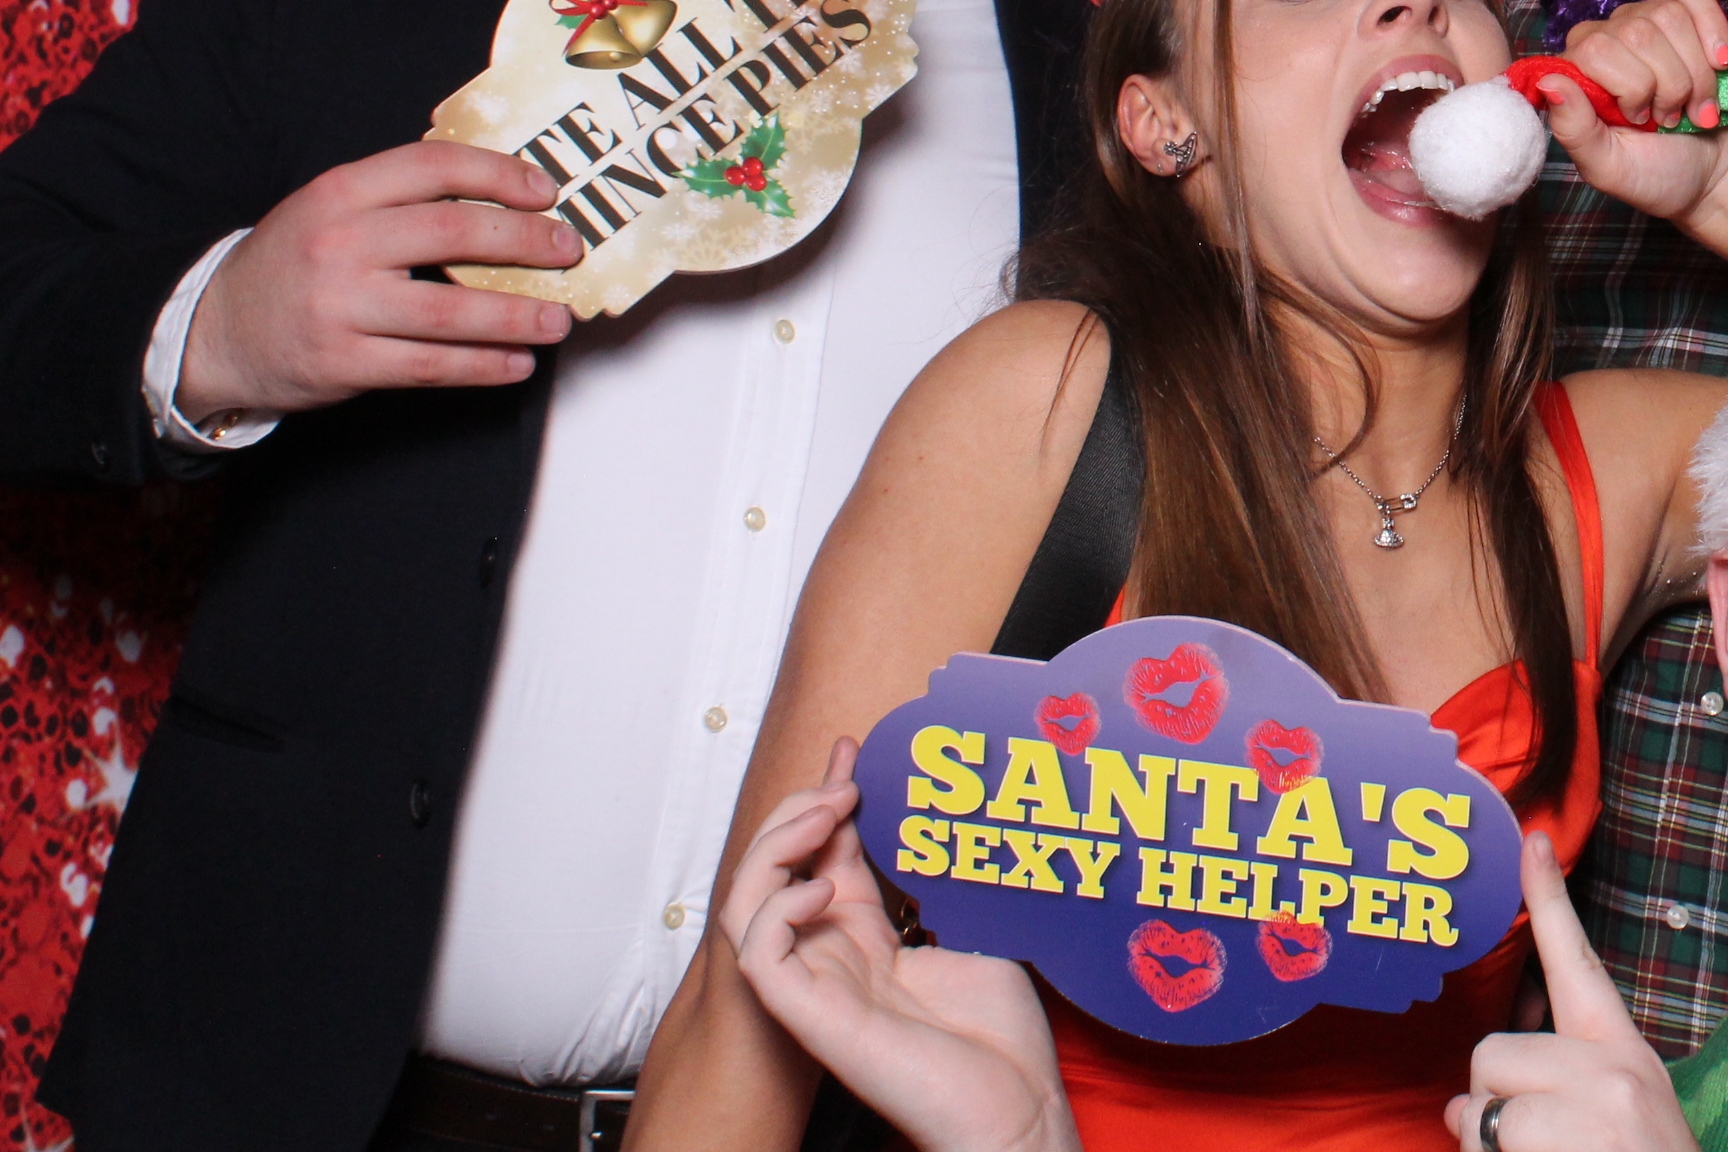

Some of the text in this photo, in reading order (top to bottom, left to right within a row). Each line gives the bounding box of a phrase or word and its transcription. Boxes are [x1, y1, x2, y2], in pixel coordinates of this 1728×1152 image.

[512, 101, 622, 189] TE
[617, 17, 743, 131] ALL
[906, 724, 1472, 880] SANTA'S
[896, 815, 1460, 947] SEXY HELPER
